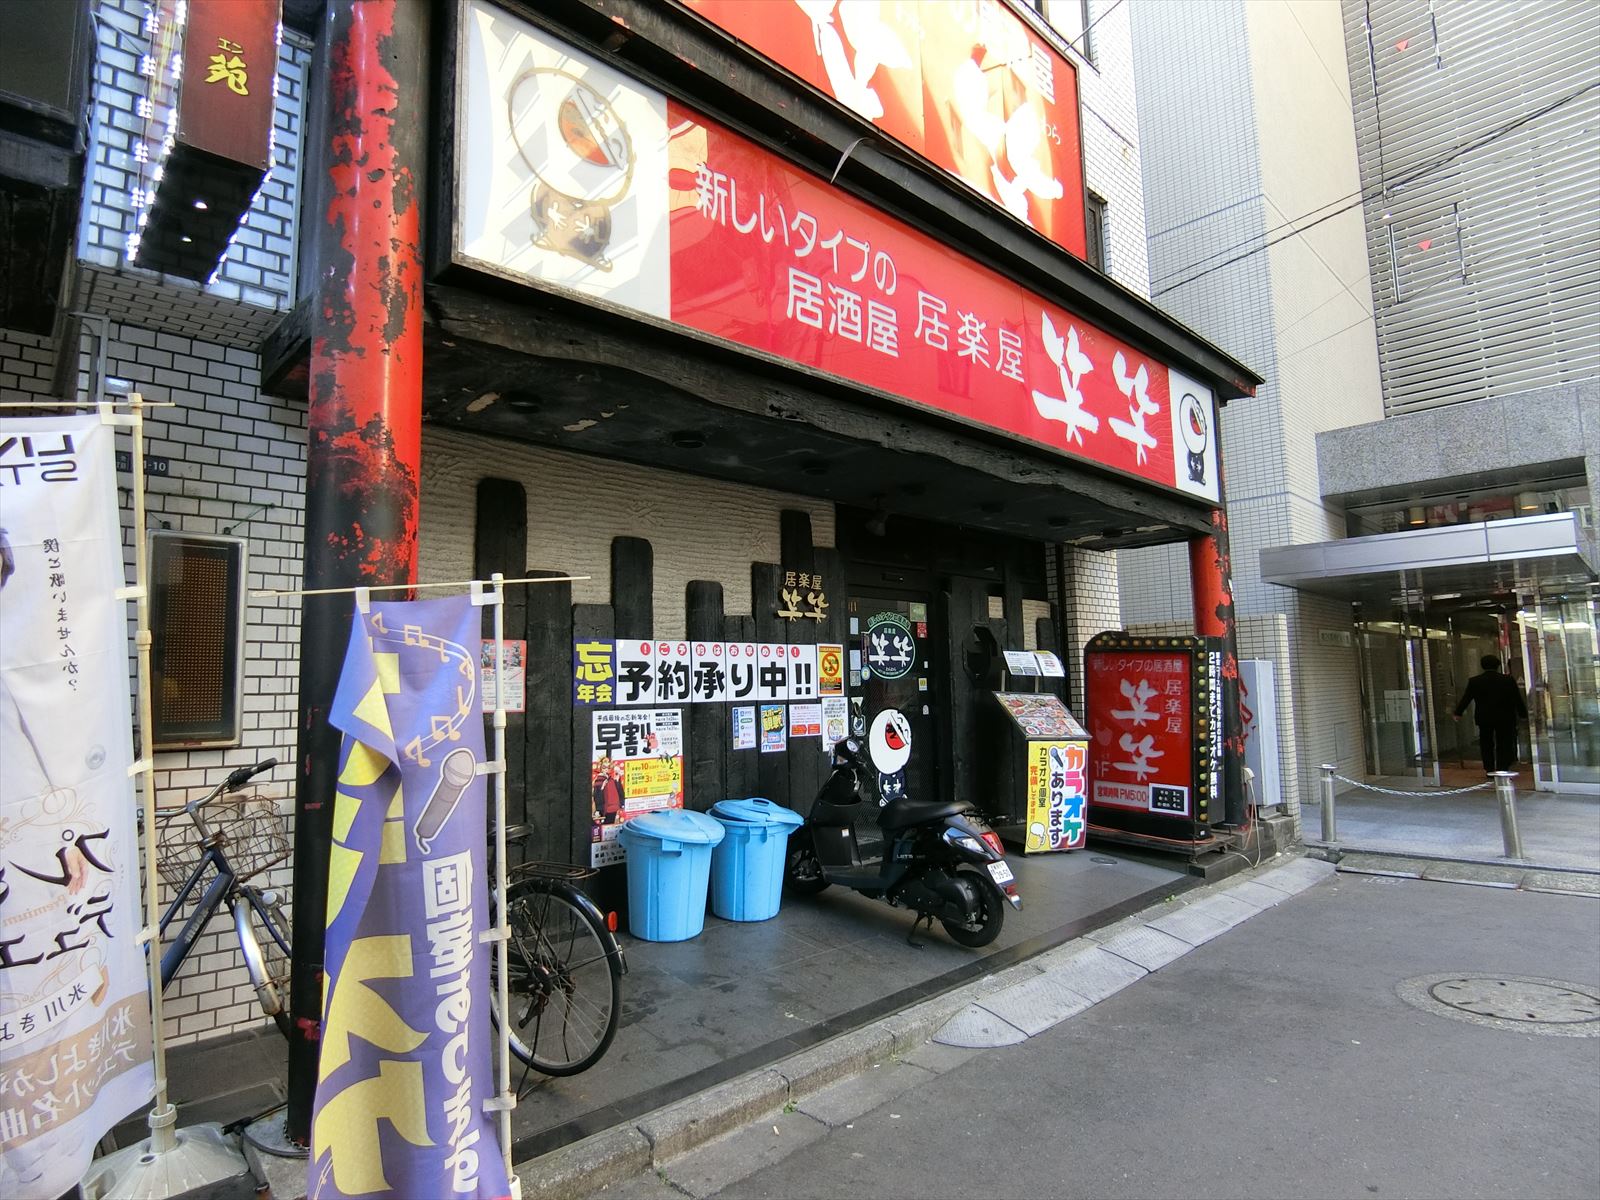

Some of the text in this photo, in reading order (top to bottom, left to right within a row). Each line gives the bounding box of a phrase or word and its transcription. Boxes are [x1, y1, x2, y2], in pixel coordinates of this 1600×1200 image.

[218, 37, 243, 54] エン
[204, 54, 249, 95] 苑
[693, 161, 898, 296] 新しいタイプの
[786, 267, 900, 358] 居酒屋
[913, 289, 1025, 384] 居楽屋
[784, 571, 823, 591] 居楽屋
[618, 660, 811, 702] 予約承り中!!
[1164, 680, 1184, 734] 居楽屋
[596, 722, 653, 757] 早割
[1049, 771, 1064, 846] あります
[1063, 746, 1084, 842] カラオケ
